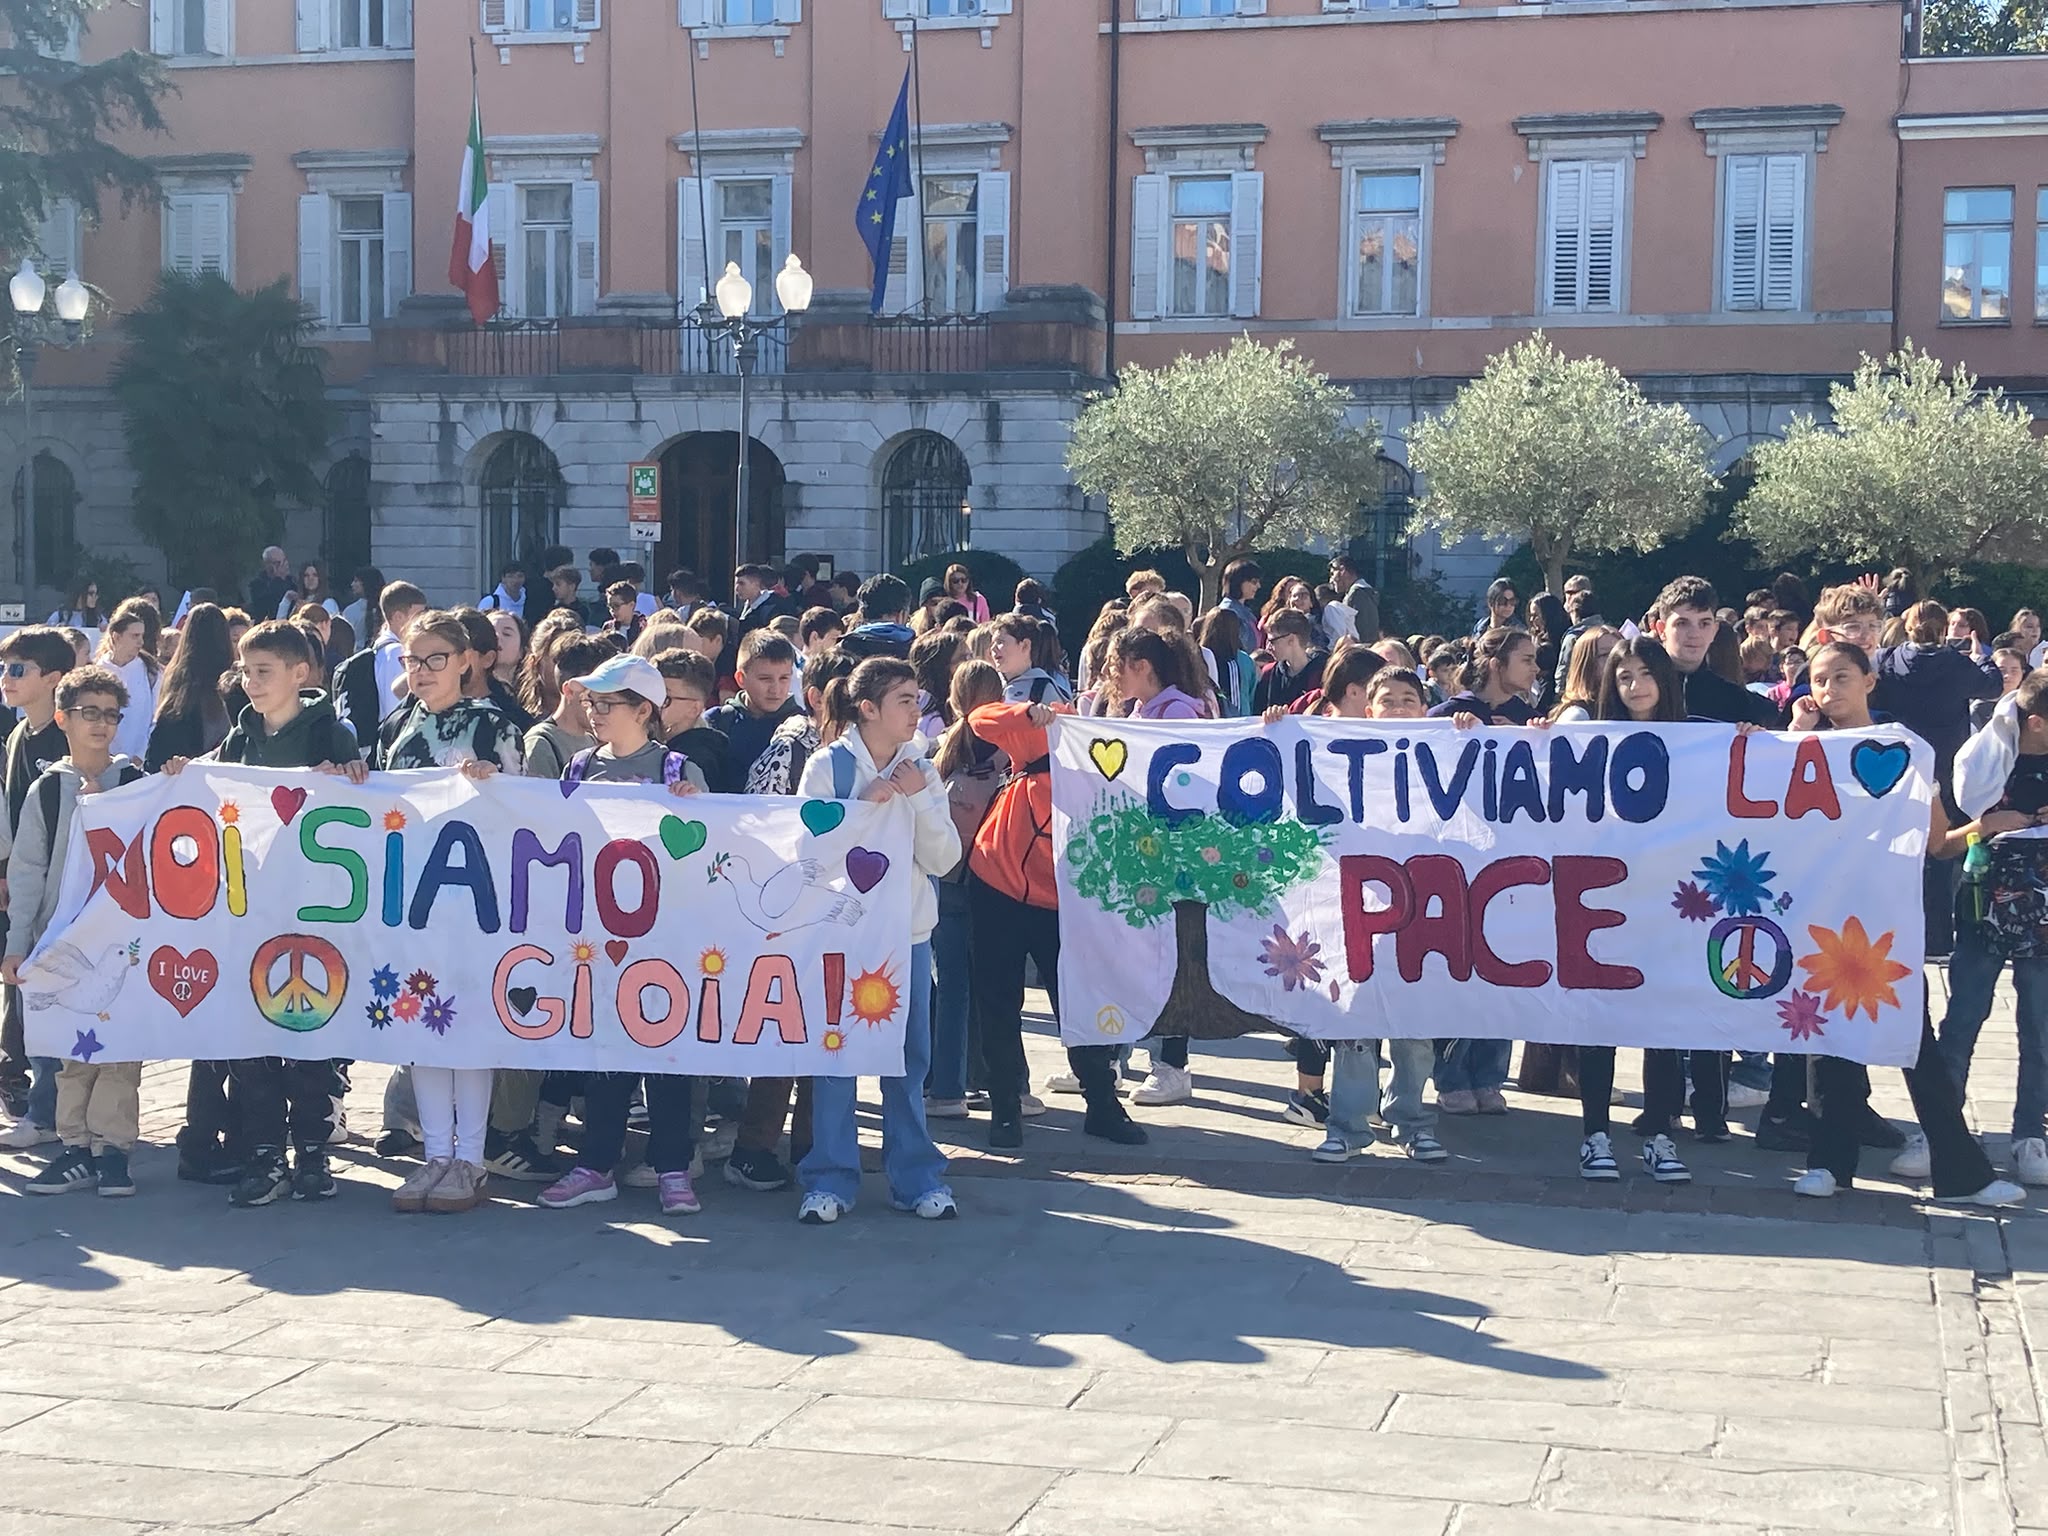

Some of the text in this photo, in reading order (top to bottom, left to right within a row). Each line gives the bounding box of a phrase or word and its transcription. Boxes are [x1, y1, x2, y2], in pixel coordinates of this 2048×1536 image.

[1727, 735, 1841, 820] LA
[1340, 854, 1645, 990] PACE
[158, 961, 209, 984] I LOVE
